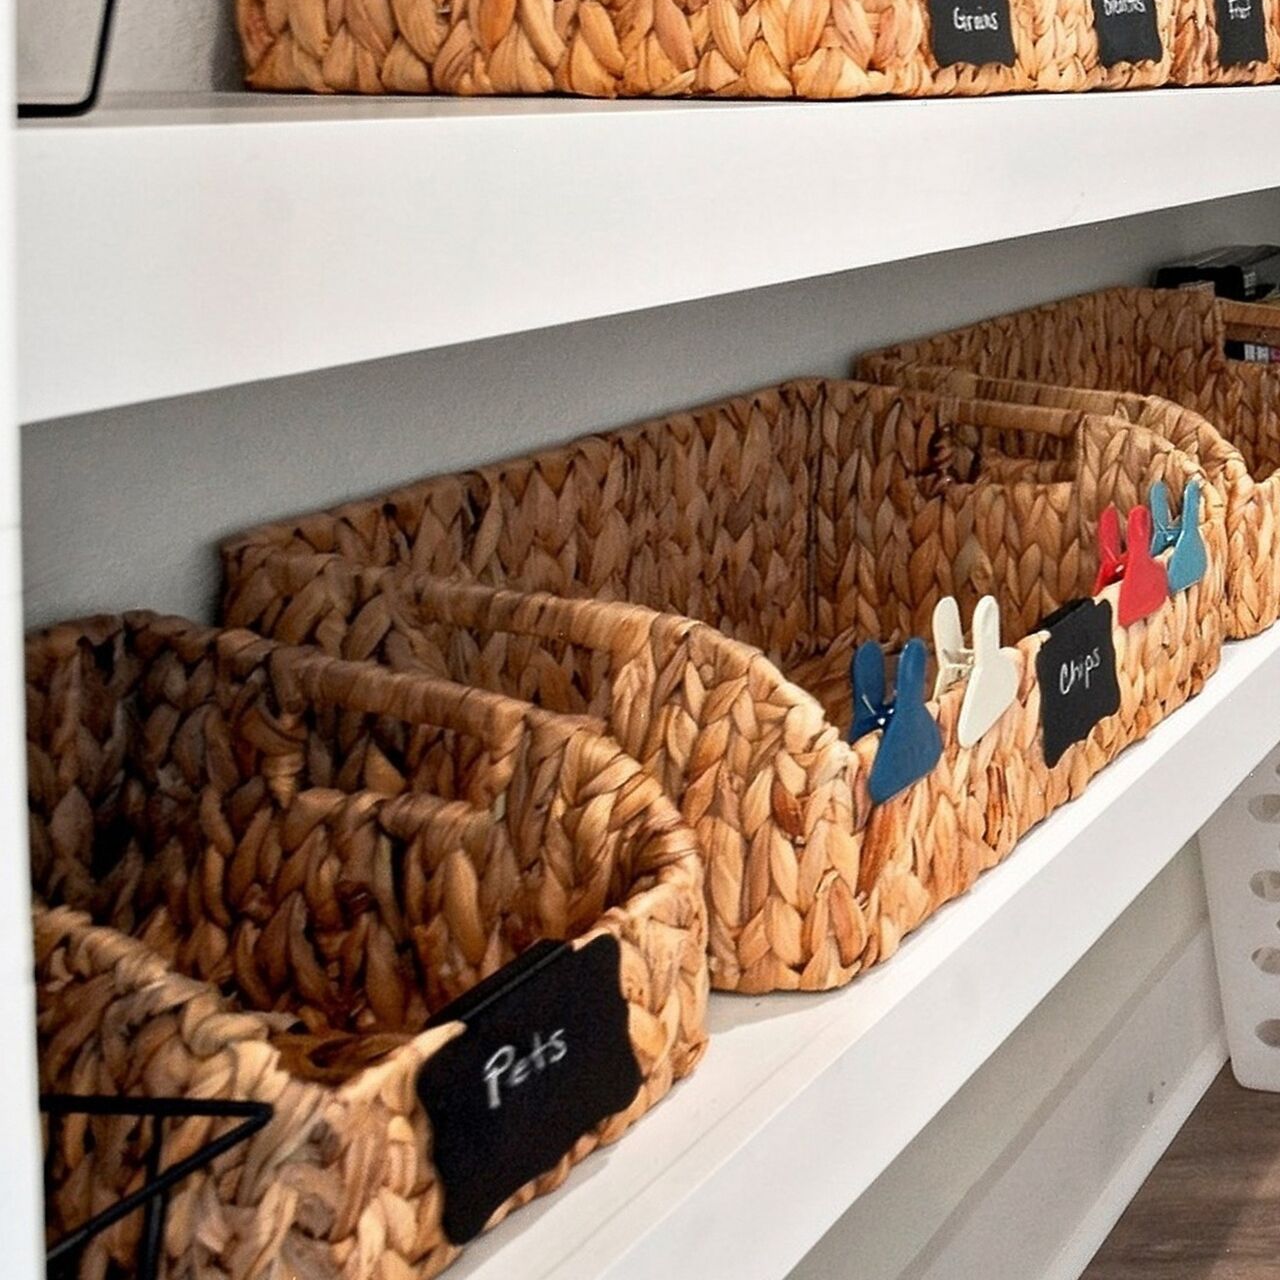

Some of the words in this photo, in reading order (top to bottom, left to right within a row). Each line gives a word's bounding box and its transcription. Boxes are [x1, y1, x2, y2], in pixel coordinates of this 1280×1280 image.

[952, 6, 999, 32] Grains
[1059, 646, 1101, 696] Chips
[483, 1028, 568, 1110] Pets
